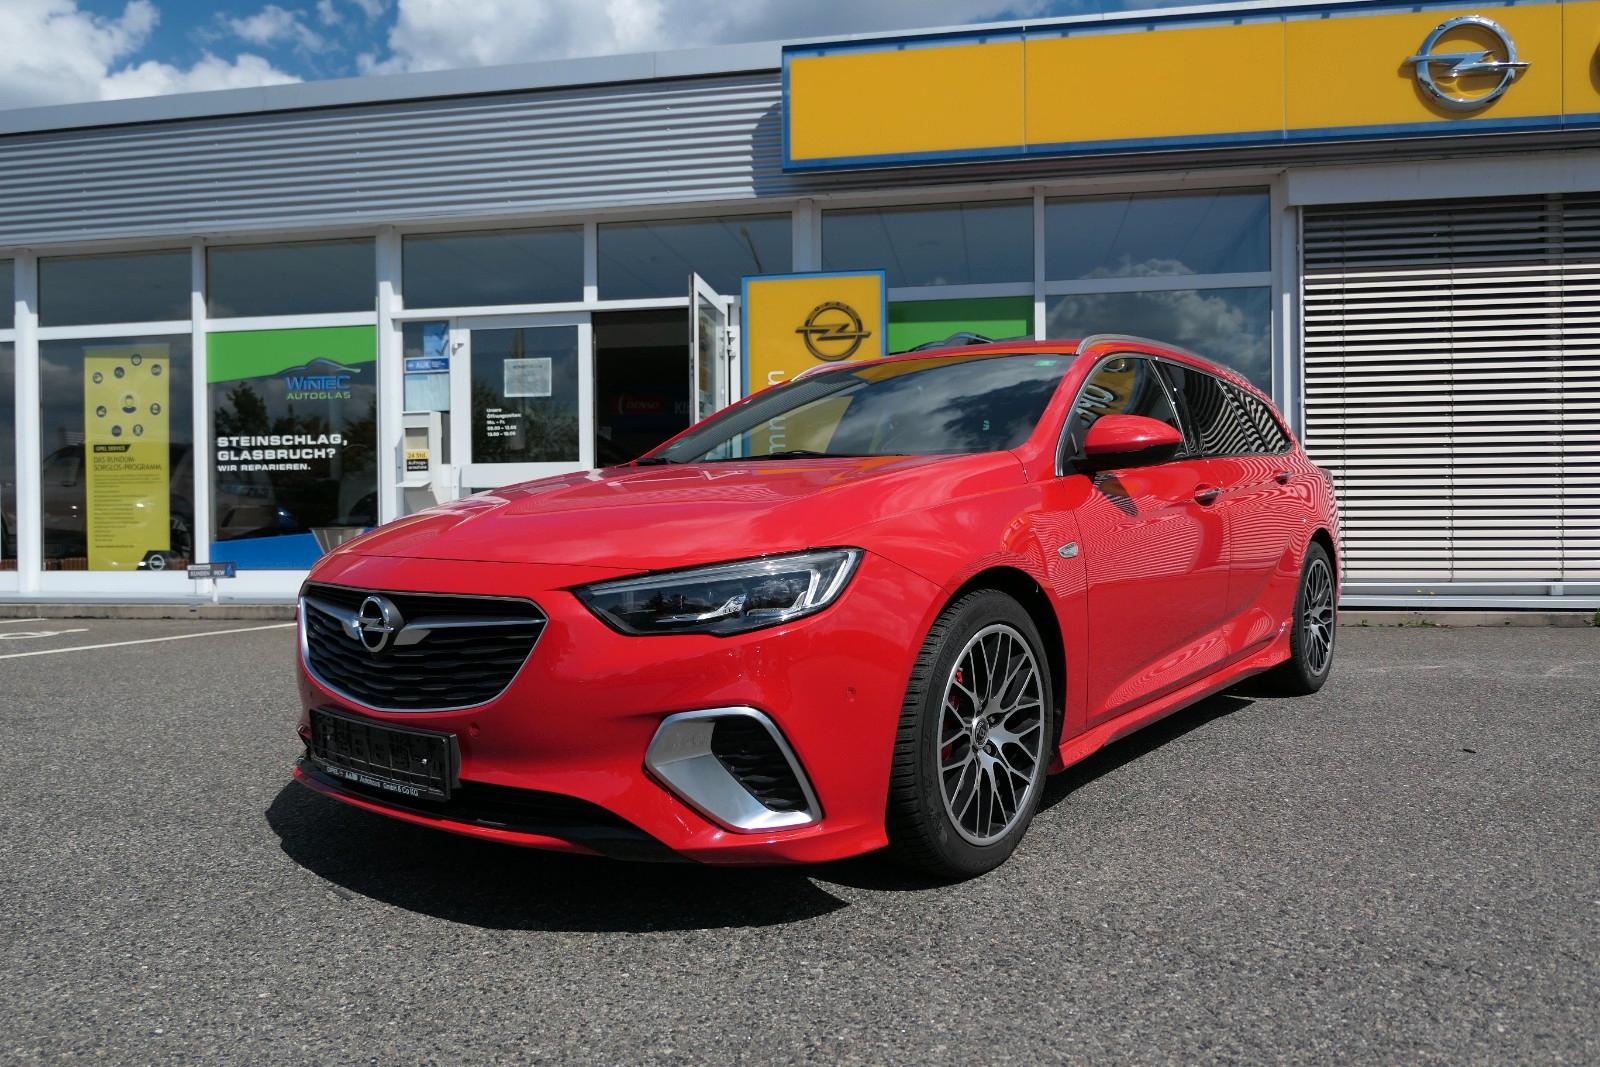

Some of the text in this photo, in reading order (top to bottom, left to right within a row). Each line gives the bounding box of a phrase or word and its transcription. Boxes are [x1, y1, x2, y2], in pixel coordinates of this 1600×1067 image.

[287, 391, 352, 400] AUTOGLAS
[217, 434, 348, 448] STEINSCHLAG,
[217, 448, 336, 461] GLASBRUCH?
[217, 463, 311, 472] WIR REPARIEREN.
